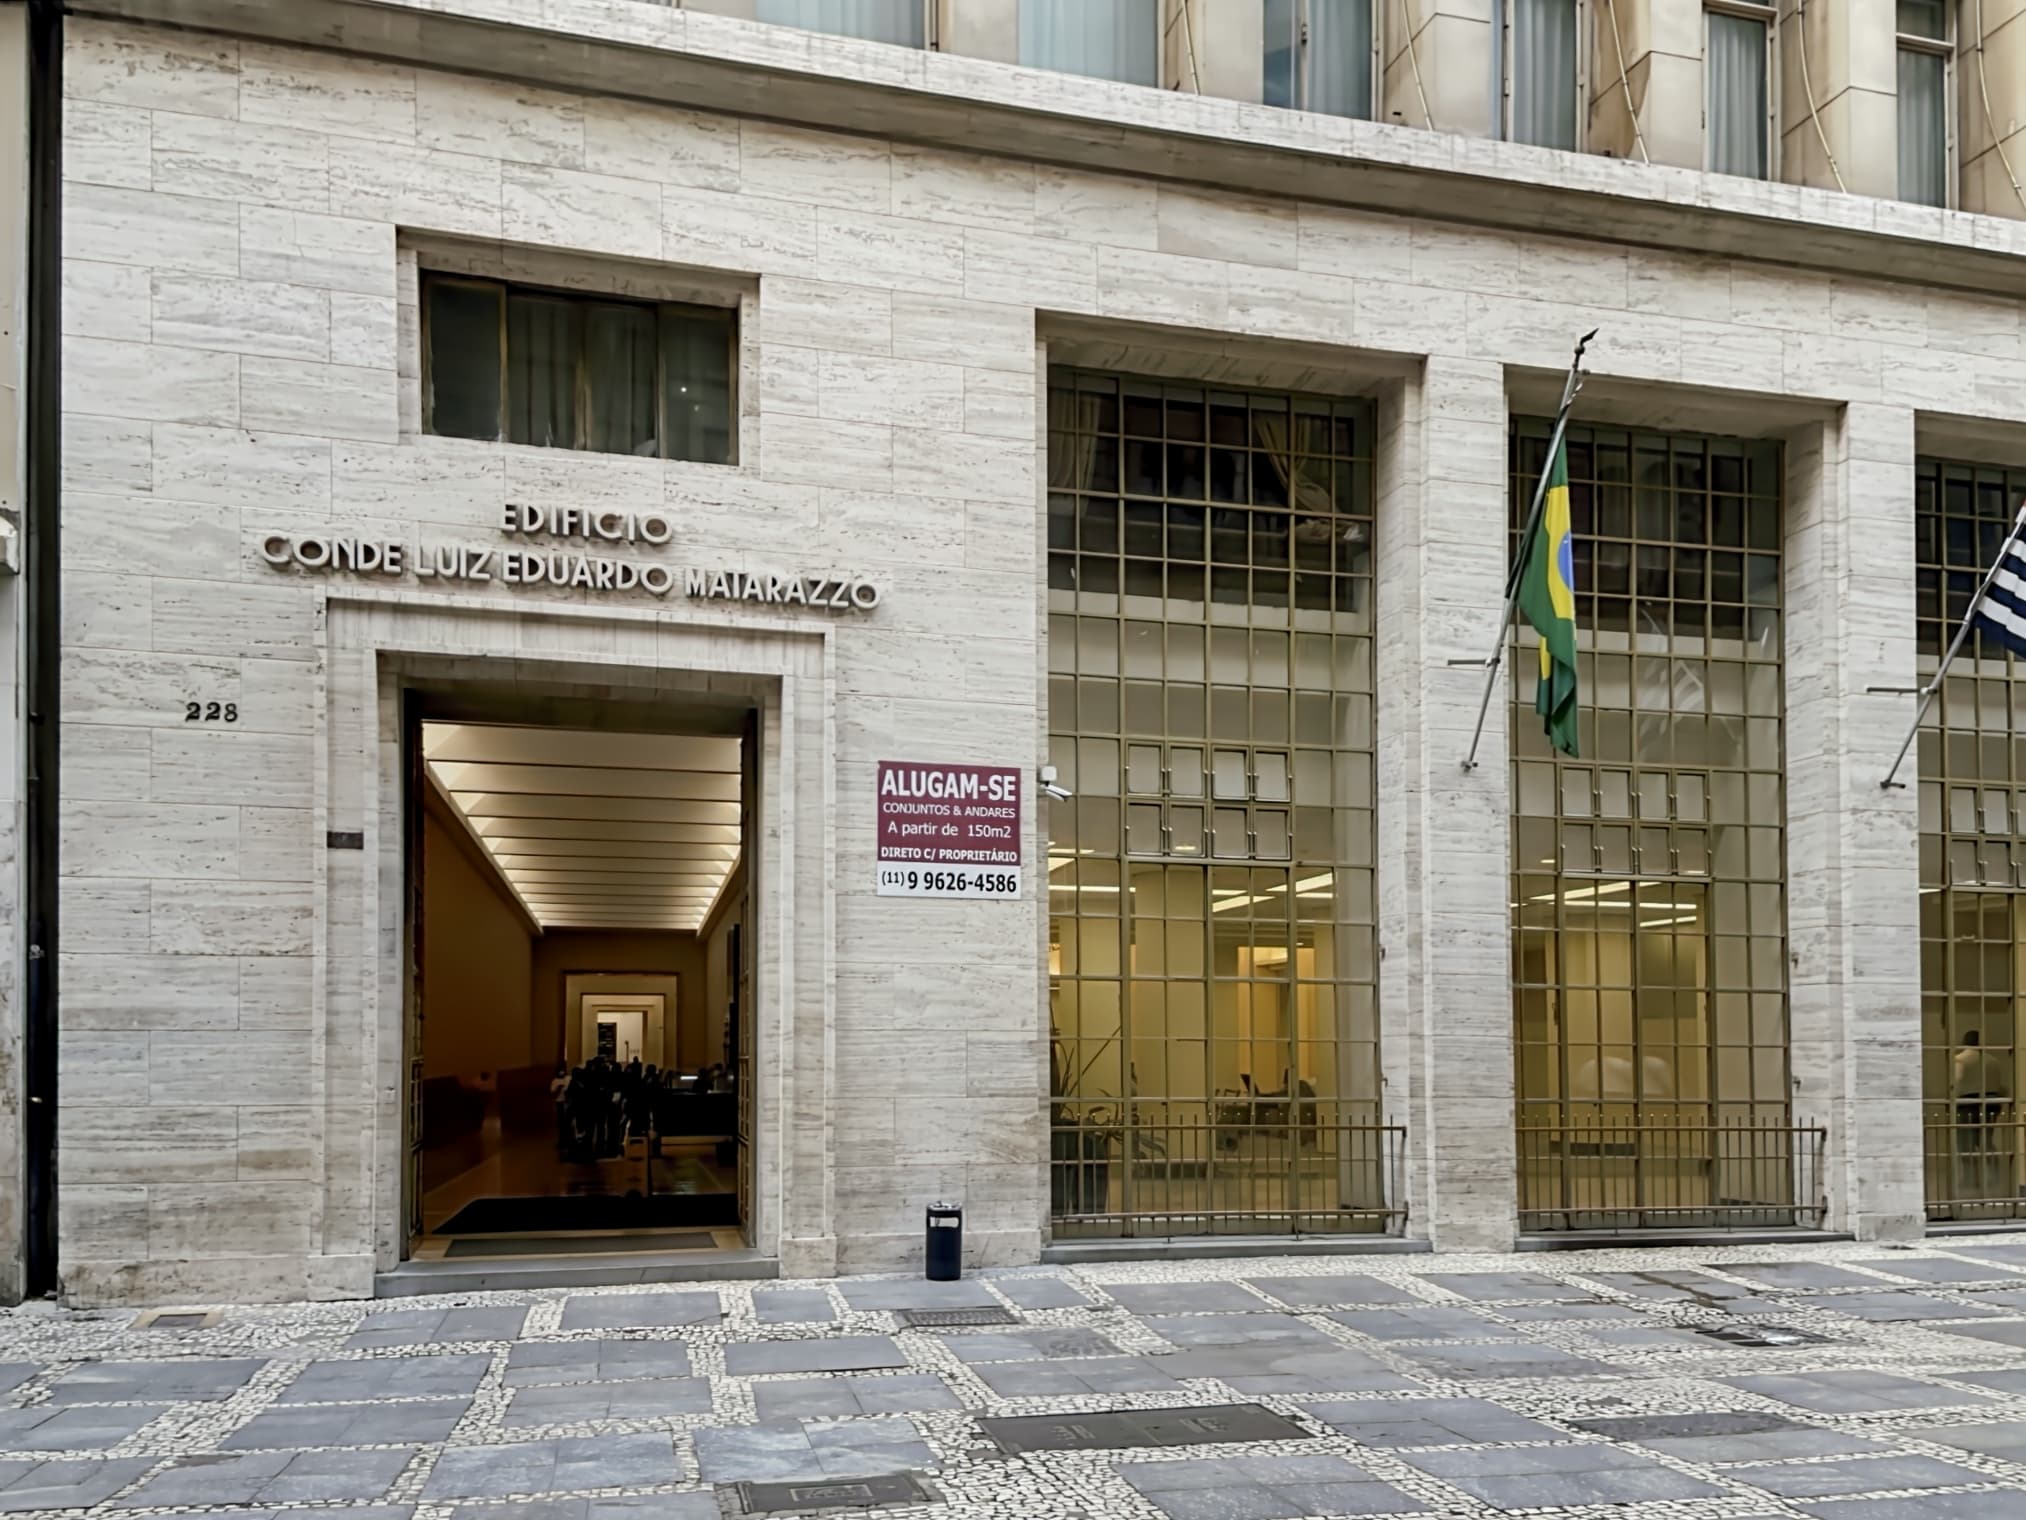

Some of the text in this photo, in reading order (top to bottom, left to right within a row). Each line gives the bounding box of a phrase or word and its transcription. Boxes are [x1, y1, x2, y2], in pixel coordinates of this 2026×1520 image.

[502, 503, 673, 545] EDIFICIO
[263, 535, 881, 611] CONDE LUIZ EDUARDO MATARAZZO
[184, 701, 239, 723] 228
[881, 769, 1017, 802] ALUGAM-SE
[883, 802, 1016, 818] CONJUNTOS & ANDARES
[888, 821, 1012, 839] A partir de 150m2
[881, 846, 1018, 862] DIRETO C/ PROPRIETÁRIO
[881, 871, 905, 887] (11)
[924, 872, 1017, 893] 9626-4586
